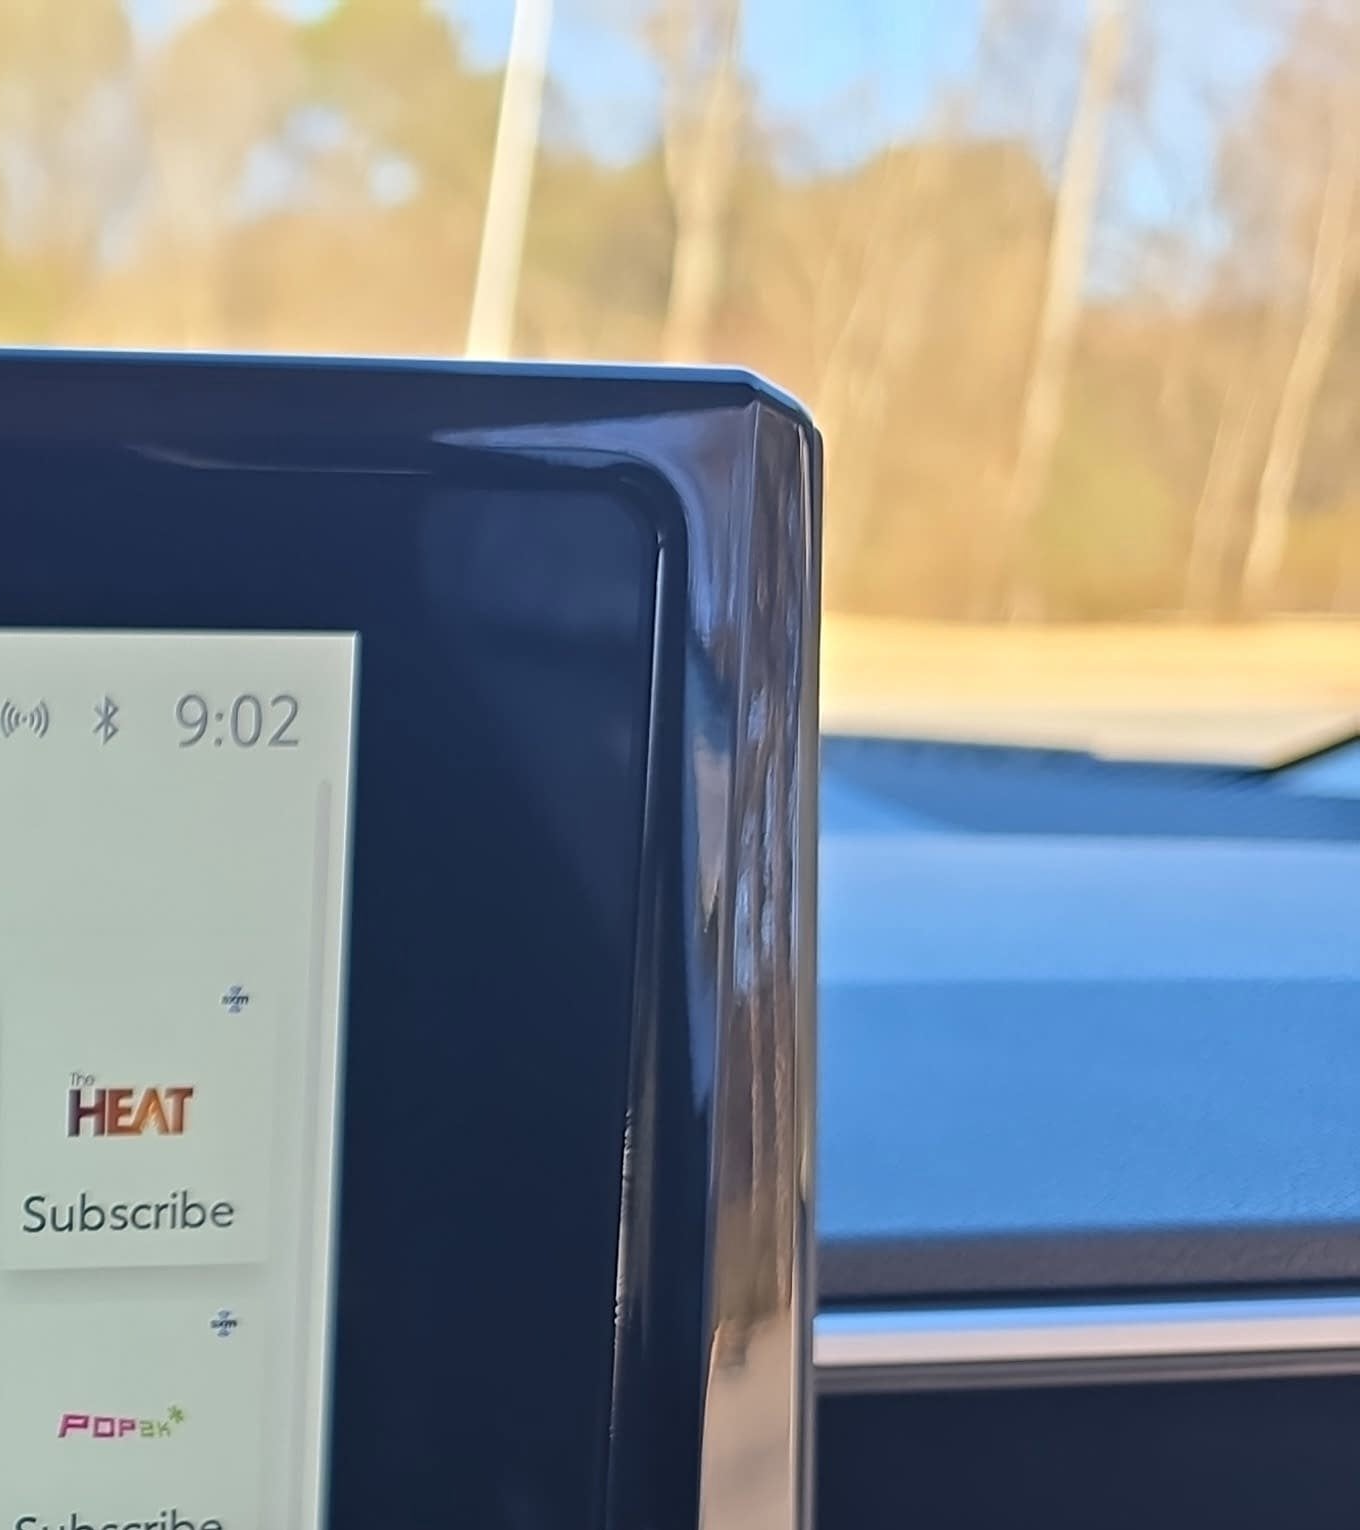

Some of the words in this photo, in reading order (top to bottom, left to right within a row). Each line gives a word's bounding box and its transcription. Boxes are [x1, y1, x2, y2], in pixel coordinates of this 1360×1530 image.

[177, 694, 299, 747] 9:02
[68, 1087, 194, 1137] HEAT
[24, 1191, 234, 1232] Subscribe
